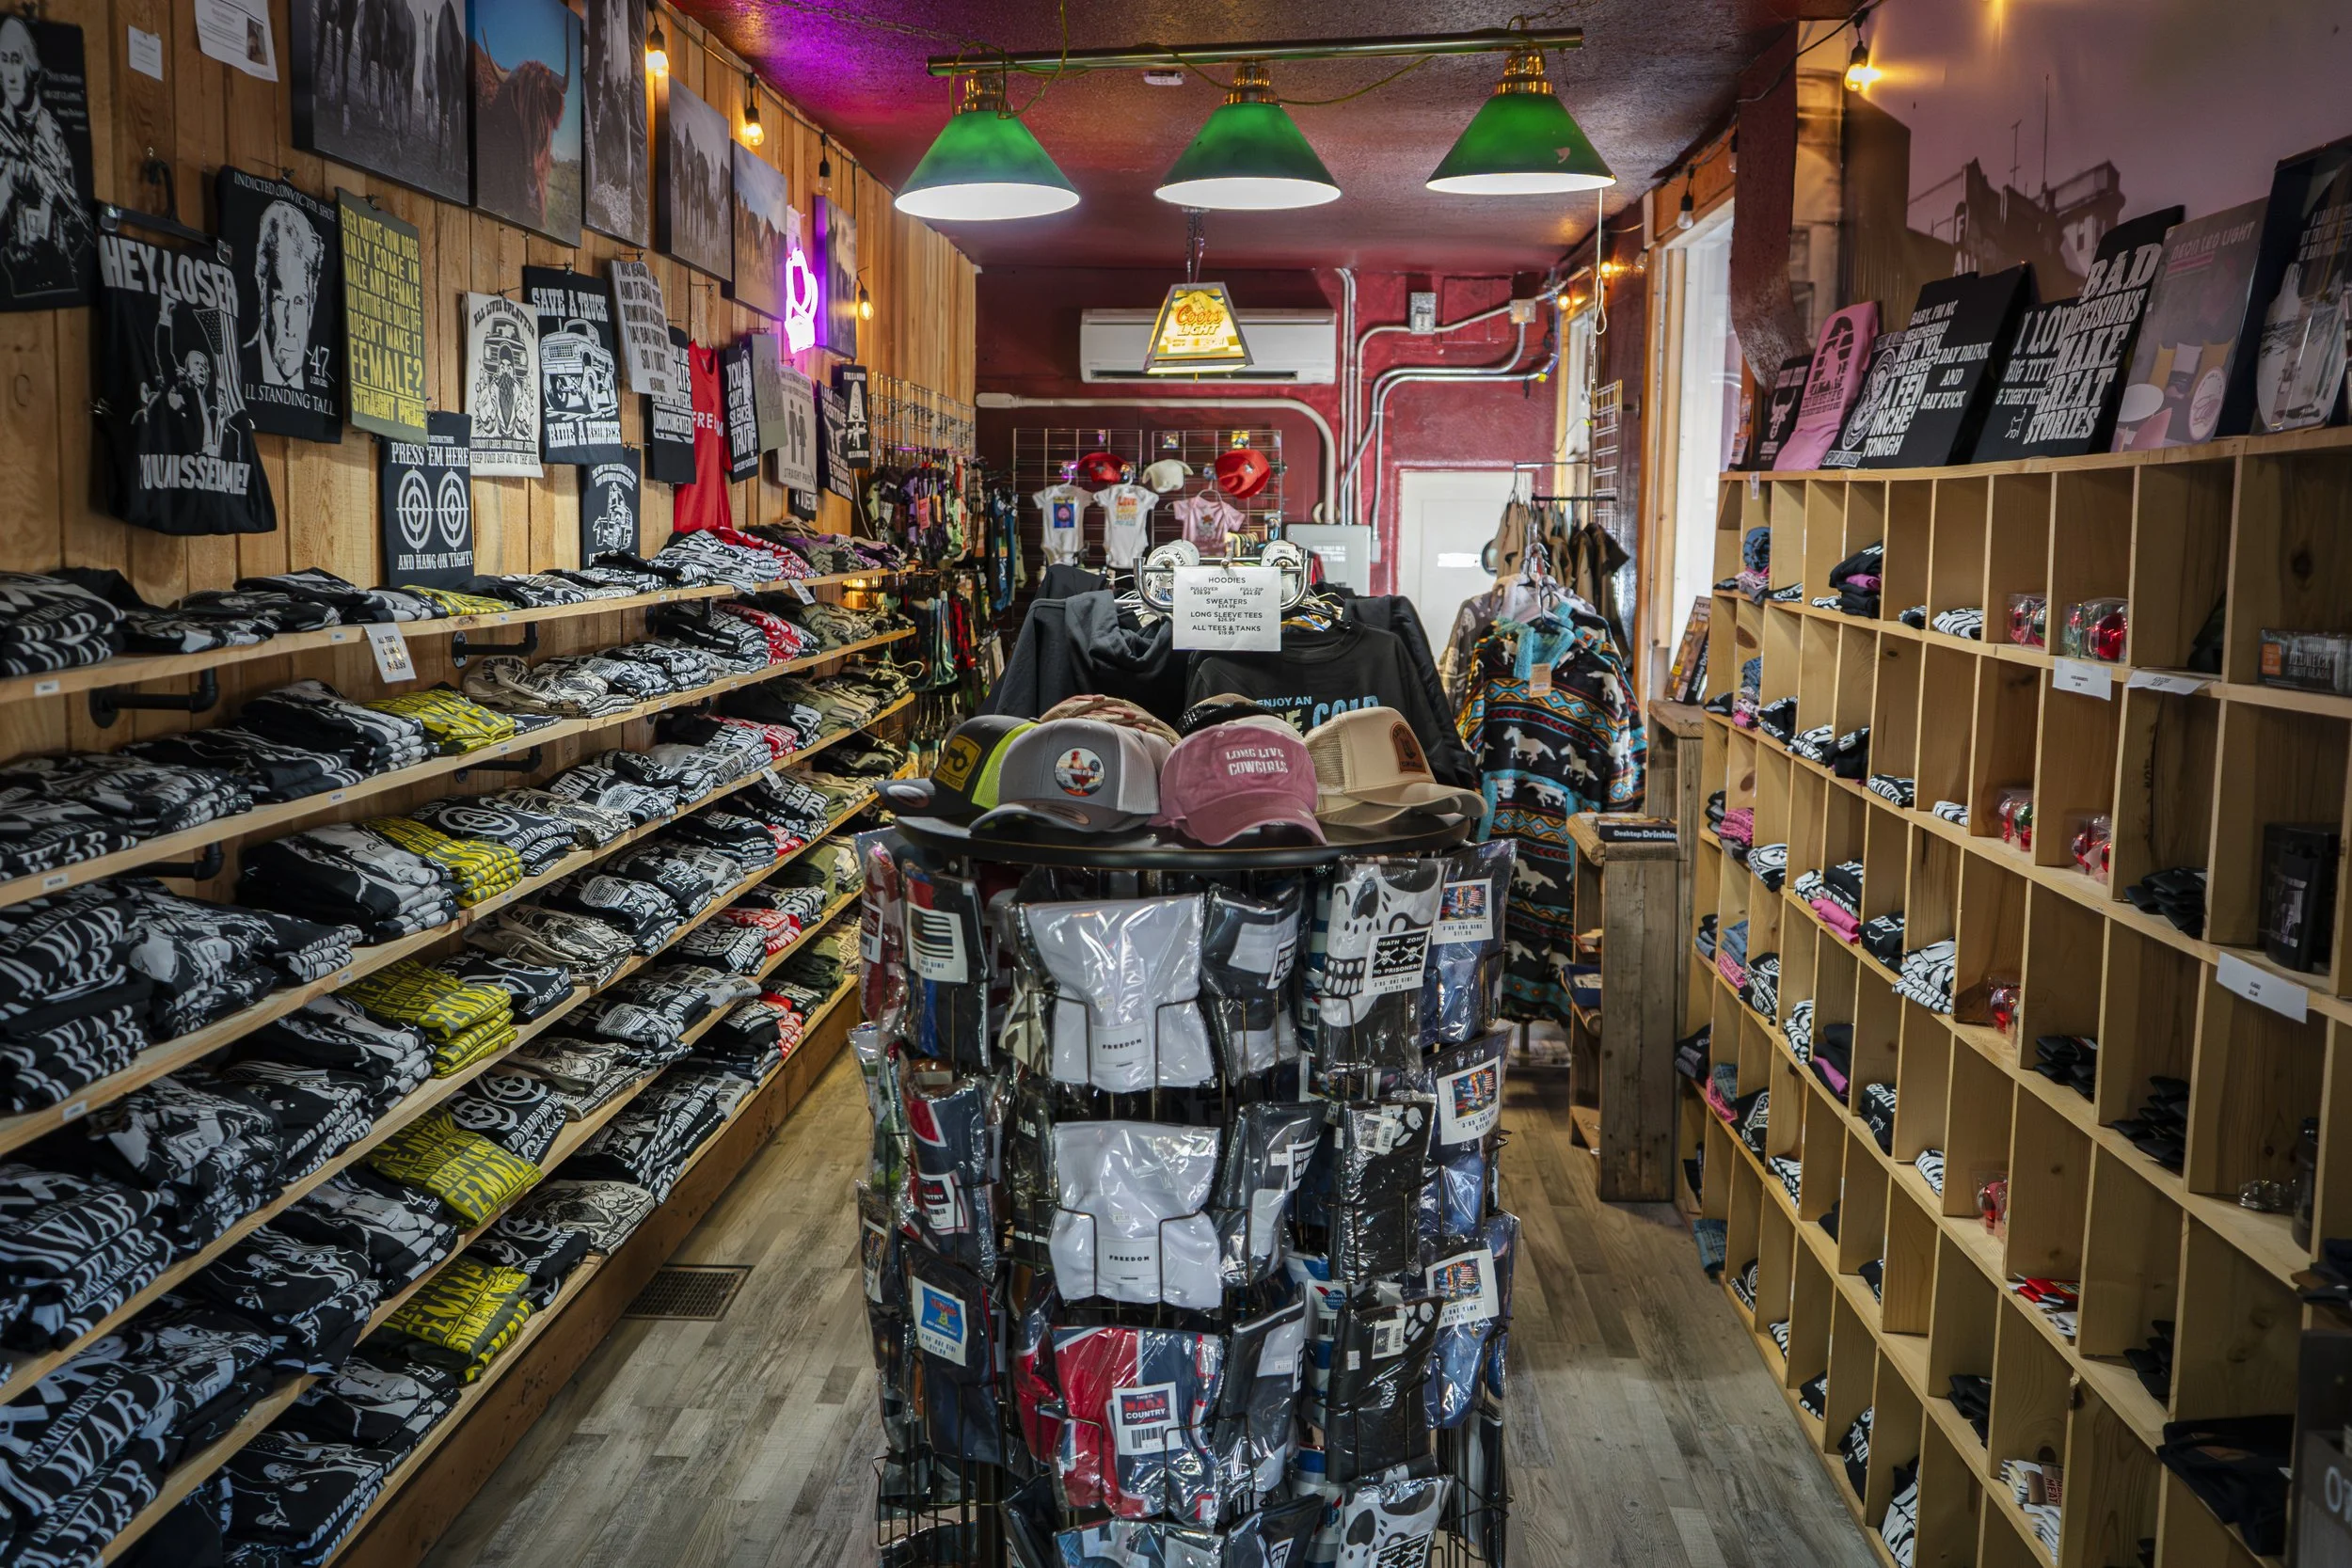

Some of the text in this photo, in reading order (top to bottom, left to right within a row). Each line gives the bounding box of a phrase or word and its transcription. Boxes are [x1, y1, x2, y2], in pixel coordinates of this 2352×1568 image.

[341, 203, 358, 236] EVER
[358, 214, 383, 245] NOTICE
[384, 226, 400, 254] HOW
[2219, 221, 2256, 247] LIGHT
[342, 230, 420, 285] ONLY COME IN
[162, 249, 240, 319] LOSER
[344, 256, 421, 310] MALE AND FEMALE
[2077, 243, 2163, 306] BAD
[531, 287, 609, 323] SAVE A TRUCK
[1176, 305, 1223, 325] Coors
[1910, 309, 1930, 326] BABY,
[2070, 288, 2147, 334] DECISIONS
[386, 325, 410, 355] MAKE
[412, 333, 421, 358] IT
[1177, 323, 1220, 337] LIGHT
[2026, 305, 2072, 355] LOV
[310, 344, 330, 377] 47
[1897, 340, 1921, 362] BUT
[1940, 346, 1963, 365] DAY
[1959, 342, 1993, 362] DRINK
[2054, 324, 2131, 377] MAKE
[349, 336, 423, 399] FEMALE?
[726, 360, 742, 391] YOU
[1892, 361, 1907, 377] CAN
[1939, 368, 1964, 387] AND
[2004, 357, 2025, 383] BIG
[259, 385, 337, 416] STANDING TALL
[1879, 377, 1896, 410] A
[1920, 390, 1967, 411] SAY FUCK
[2002, 388, 2030, 405] TIGHT
[2034, 367, 2118, 415] GREAT
[548, 420, 621, 449] RIDE A REDNECK
[2023, 406, 2101, 445] STORIES
[390, 441, 423, 464] PRESS
[445, 446, 469, 467] HERE
[1862, 434, 1904, 457] TONIGH
[397, 550, 473, 571] AND HANG ON TIGHT!
[1257, 696, 1312, 707] ENJOY AN
[1226, 747, 1284, 761] LONG LIVE
[1228, 759, 1289, 776] COWGIRLS
[1613, 830, 1642, 838] Desktop
[1377, 935, 1425, 947] DEATH ZONE
[1384, 963, 1422, 974] PRISONERS
[1102, 1037, 1142, 1050] FREEDOM
[1124, 1397, 1165, 1411] MAGA
[1125, 1407, 1166, 1419] COUNTRY
[16, 1367, 125, 1473] DEPARTMENT OF
[41, 1388, 148, 1488] WAR
